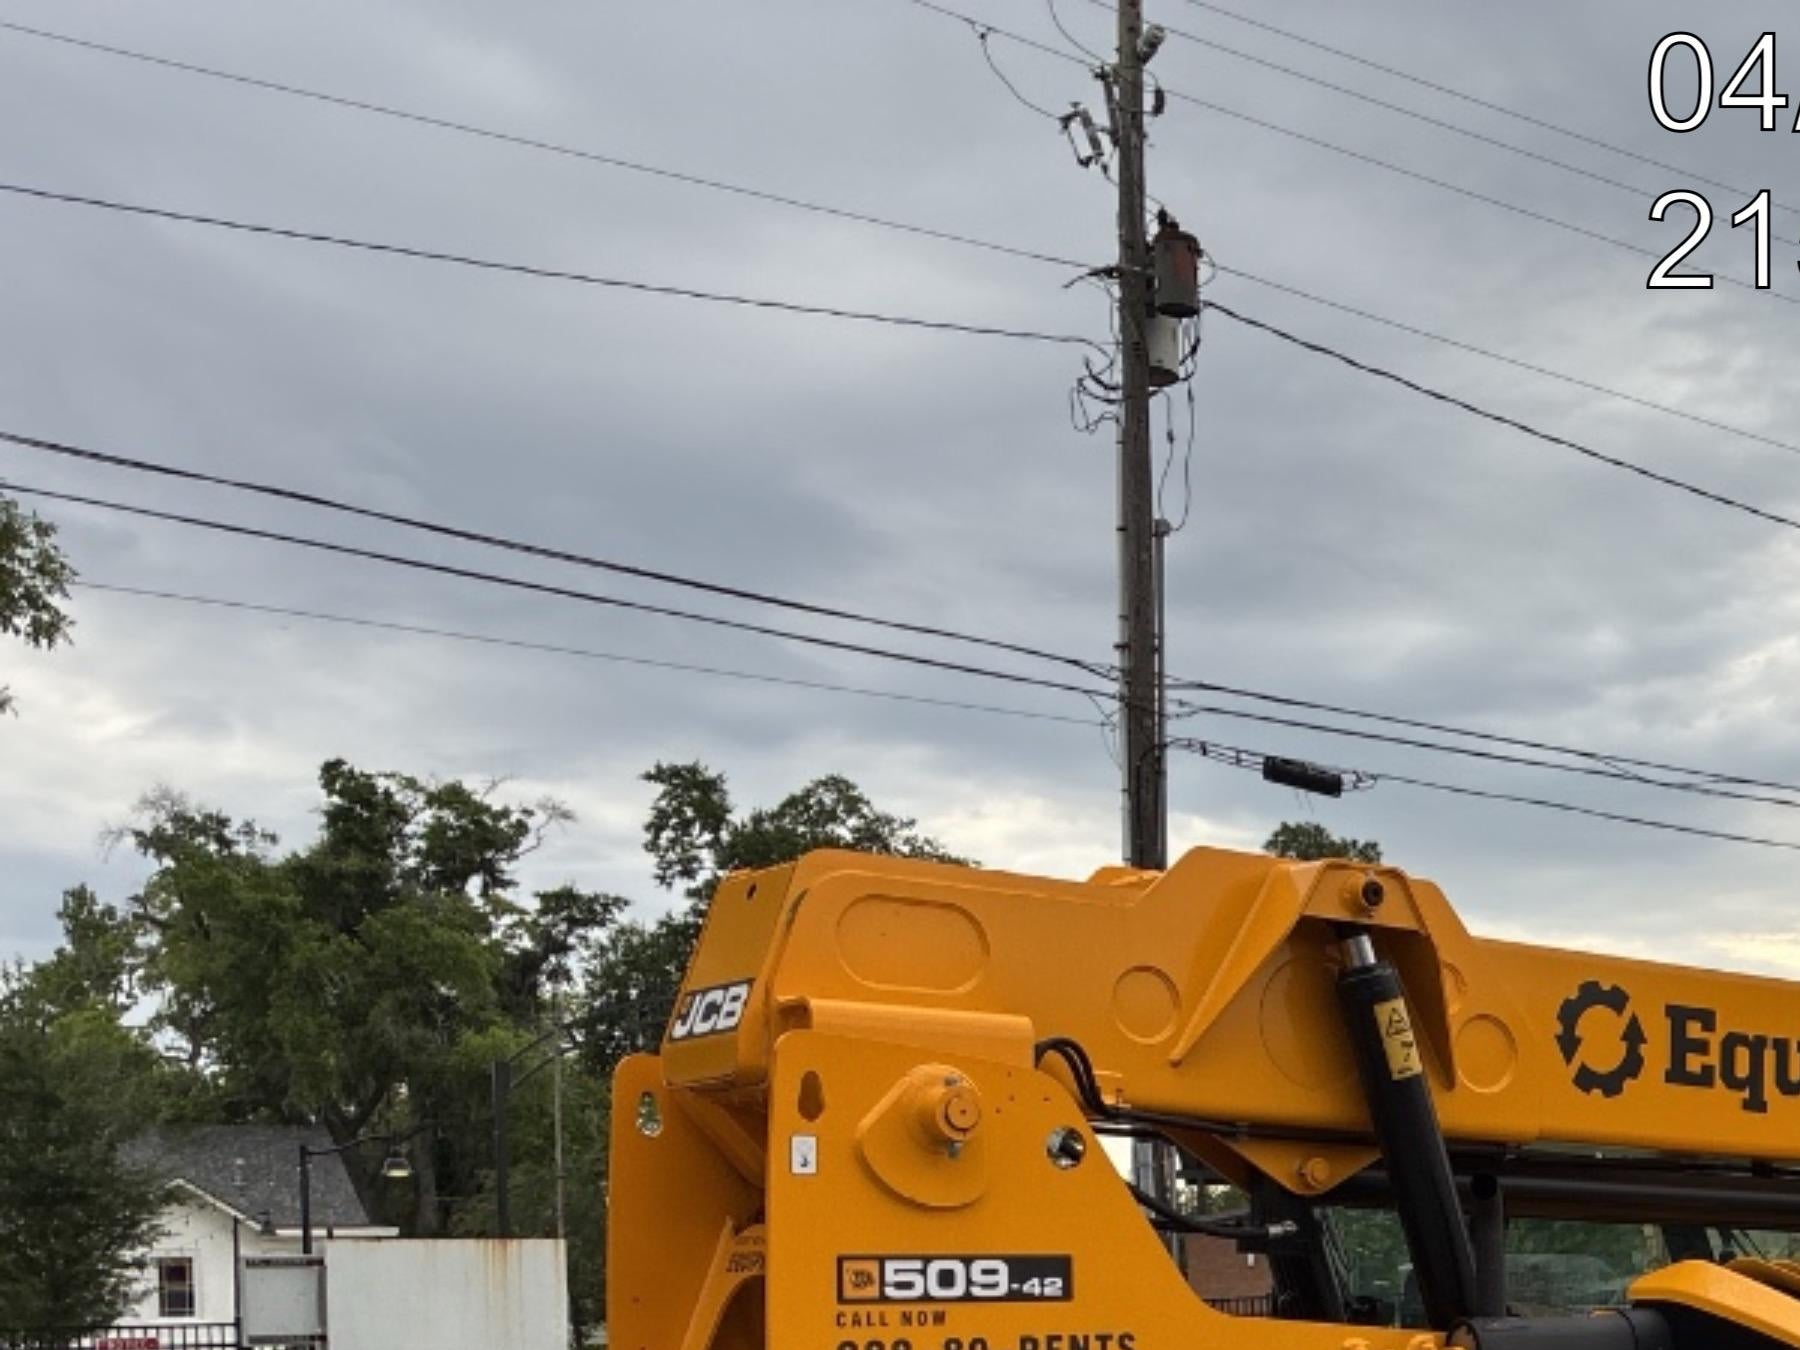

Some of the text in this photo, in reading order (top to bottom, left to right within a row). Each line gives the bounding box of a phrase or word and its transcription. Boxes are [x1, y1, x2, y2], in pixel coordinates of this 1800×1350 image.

[672, 983, 748, 1039] JCB
[884, 1258, 1063, 1299] 509-42
[836, 1310, 947, 1328] CALL NOW
